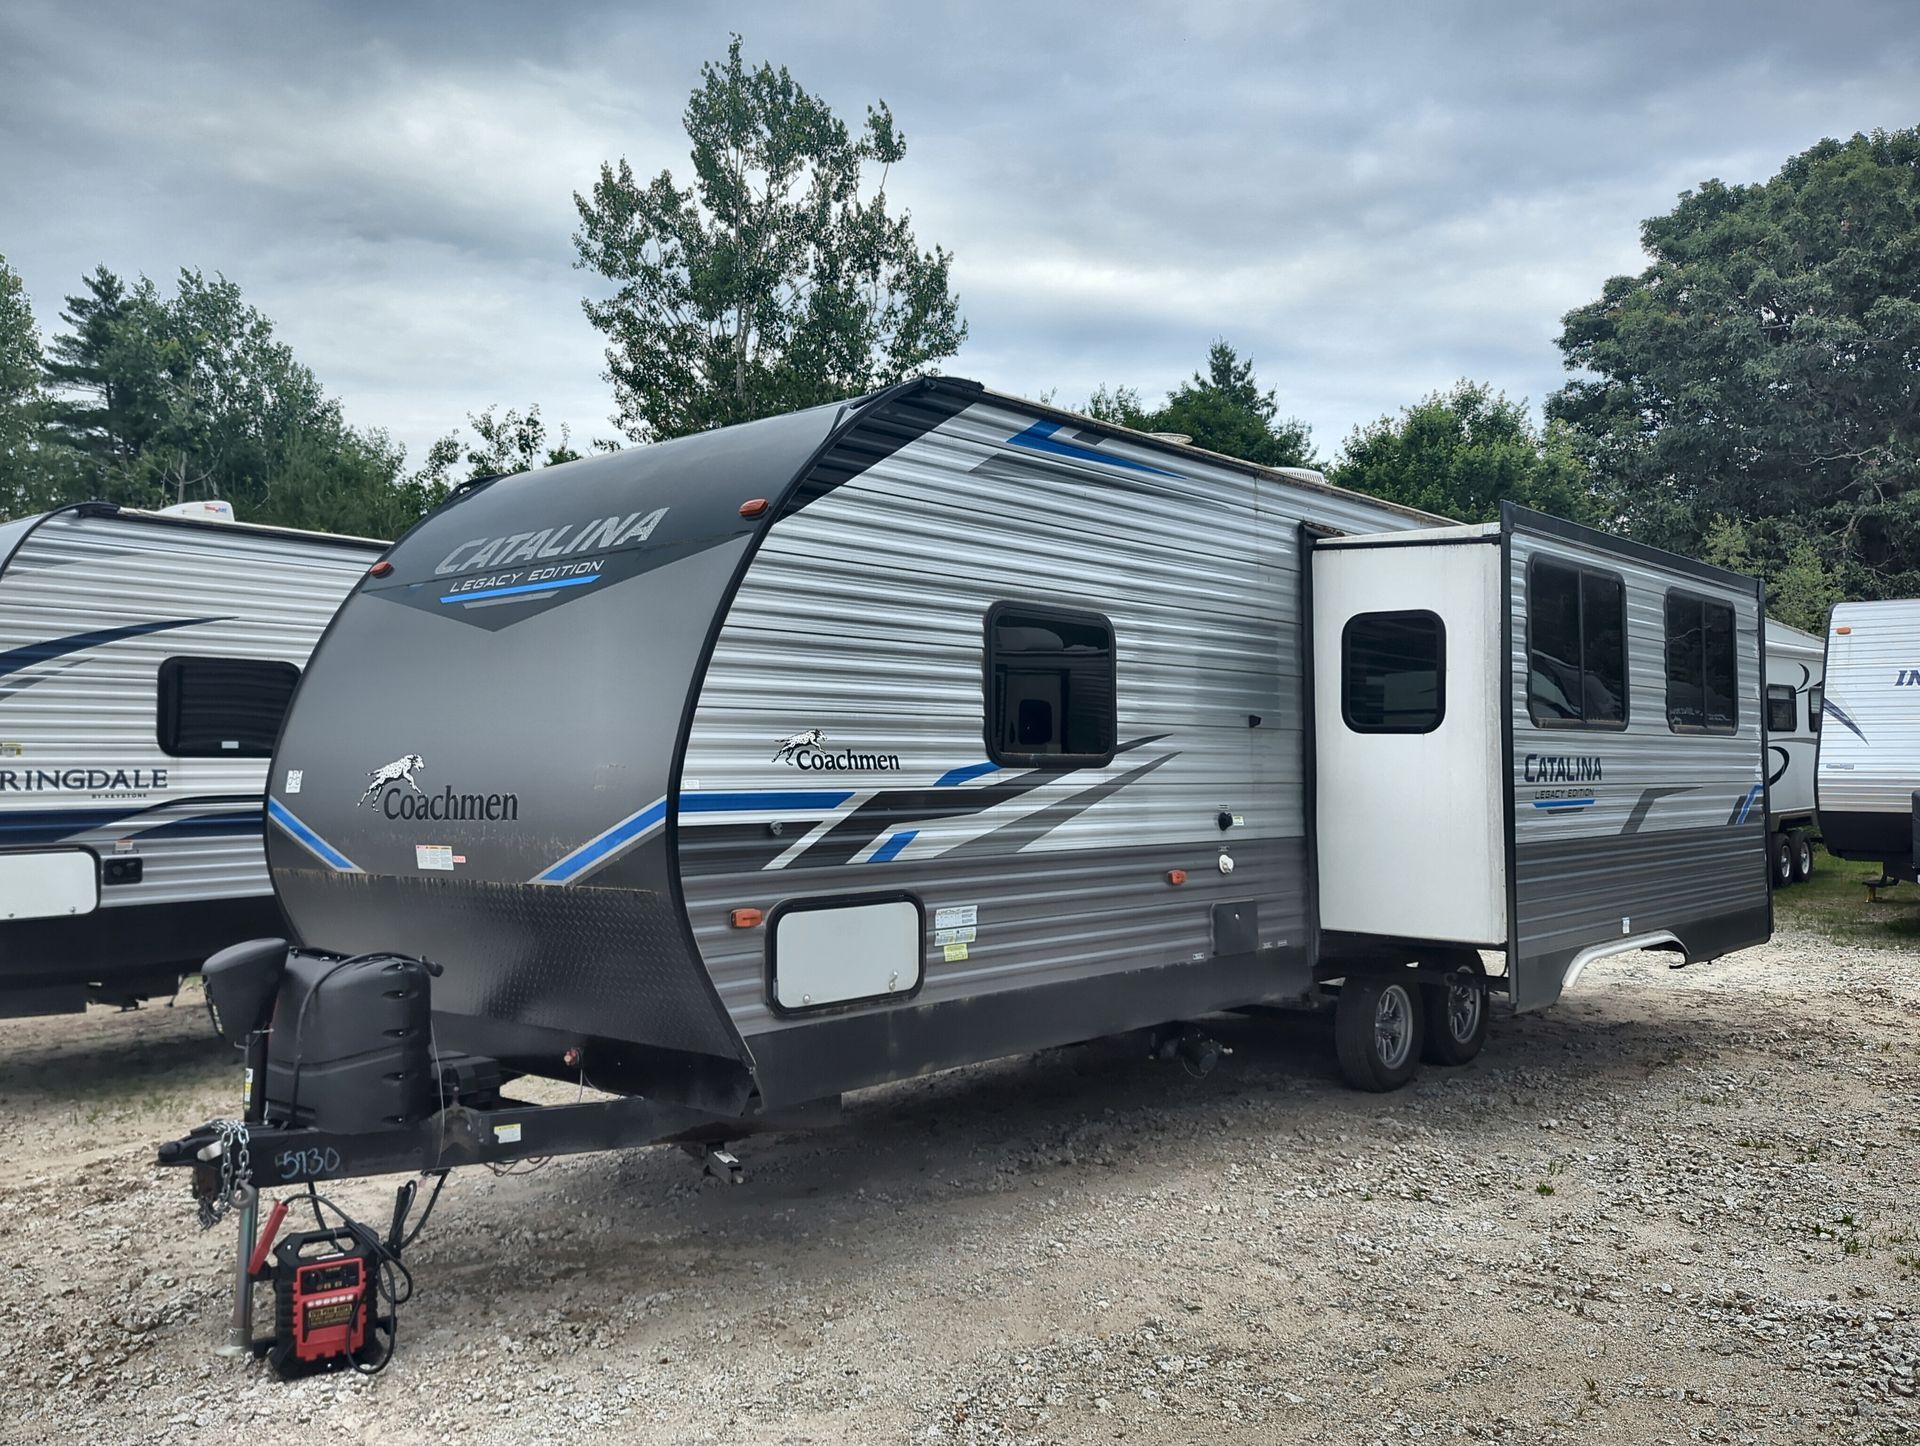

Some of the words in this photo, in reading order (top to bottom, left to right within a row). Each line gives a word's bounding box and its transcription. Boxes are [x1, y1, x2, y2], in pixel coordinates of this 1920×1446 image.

[434, 507, 671, 575] CATALINA
[449, 572, 525, 593] LEGACY
[527, 559, 605, 582] EDITION
[796, 748, 901, 771] Coachmen
[1523, 753, 1603, 783] CATALINA
[0, 769, 168, 791] RINGDALE
[1535, 790, 1566, 800] LEGACY
[1568, 787, 1595, 798] EDITION
[383, 784, 519, 821] Coachmen
